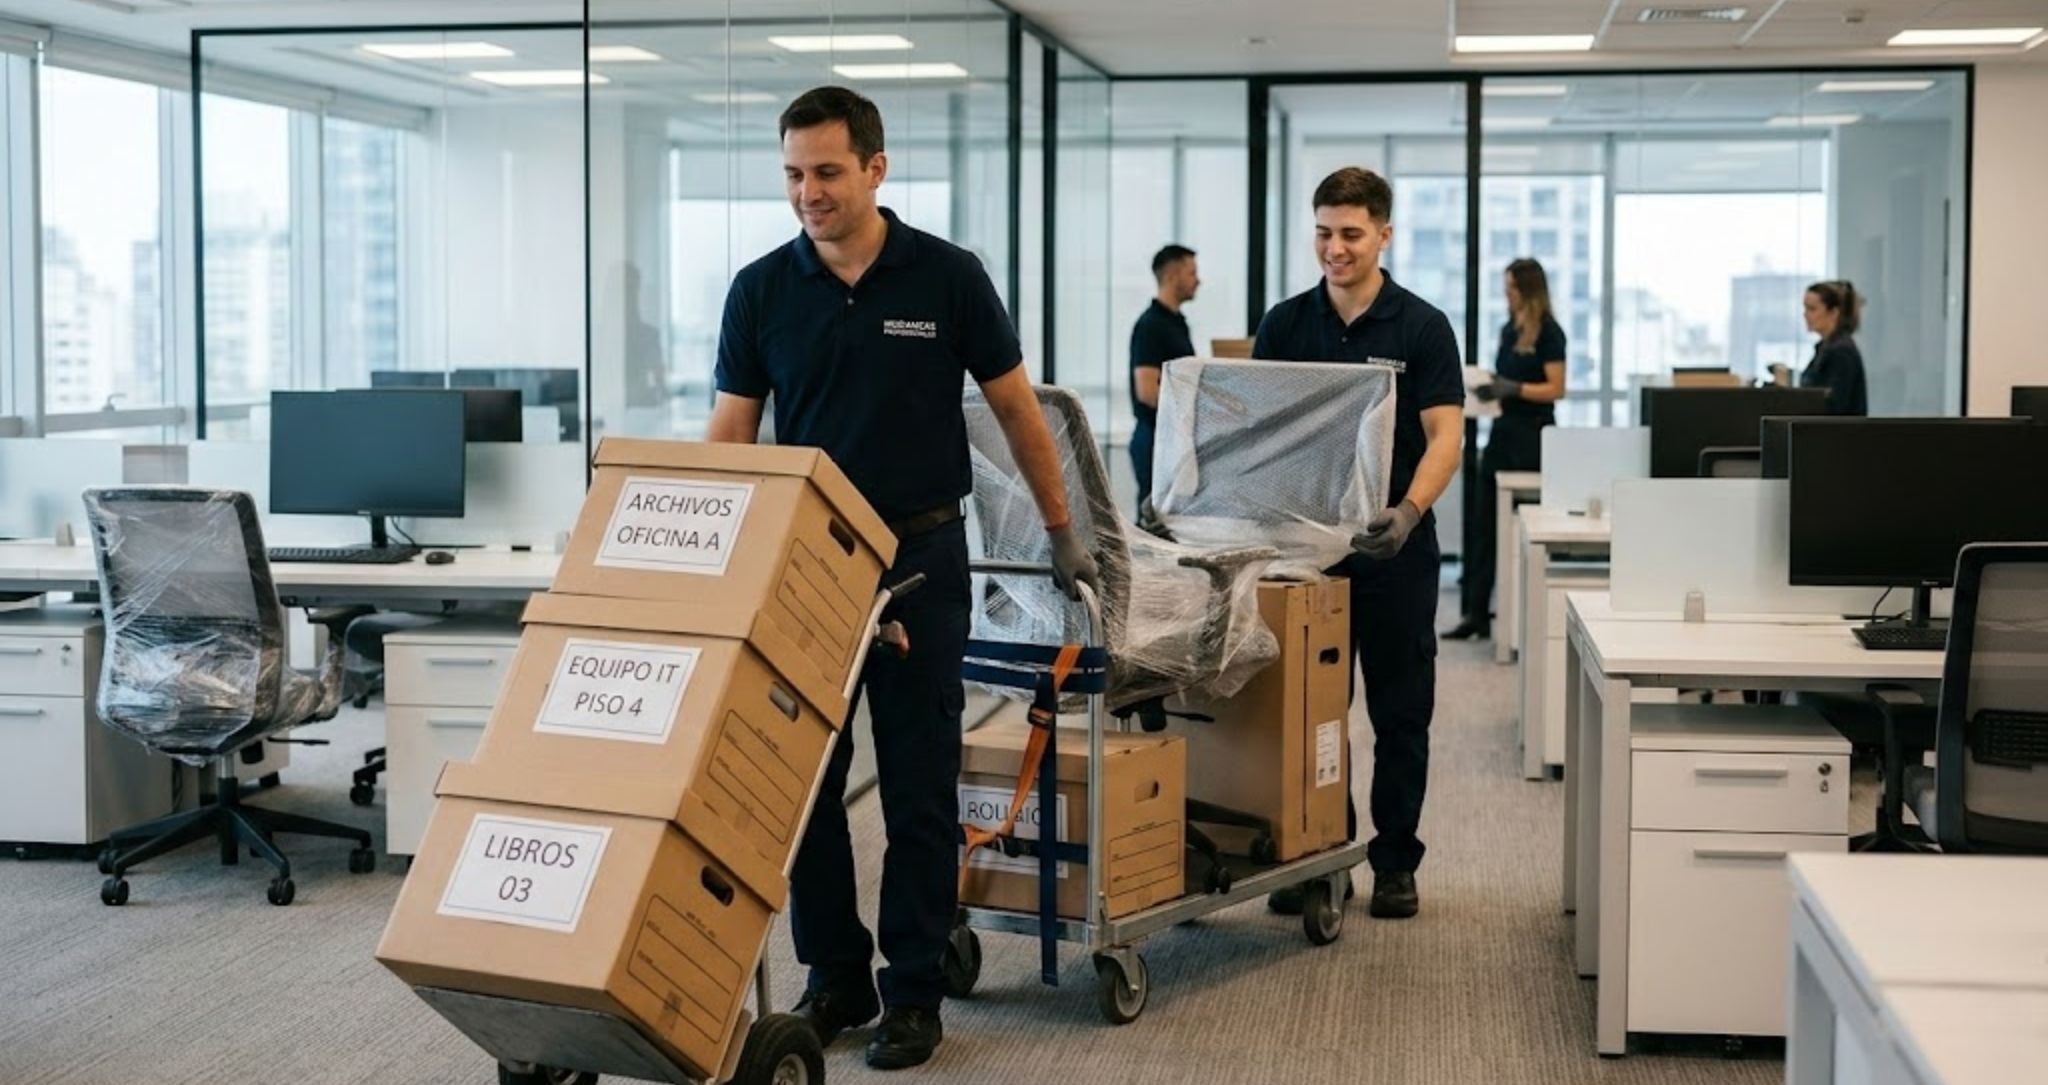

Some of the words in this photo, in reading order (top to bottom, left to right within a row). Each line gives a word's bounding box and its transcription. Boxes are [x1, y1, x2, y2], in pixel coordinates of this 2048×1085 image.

[626, 493, 733, 517] ARCHIVOS
[616, 525, 699, 548] OFICINA
[705, 532, 720, 551] A
[568, 656, 652, 681] EQUIPO
[656, 664, 680, 684] IT
[574, 693, 625, 716] PISO
[628, 698, 643, 716] 4
[484, 834, 578, 868] LIBROS
[498, 875, 533, 903] 03
